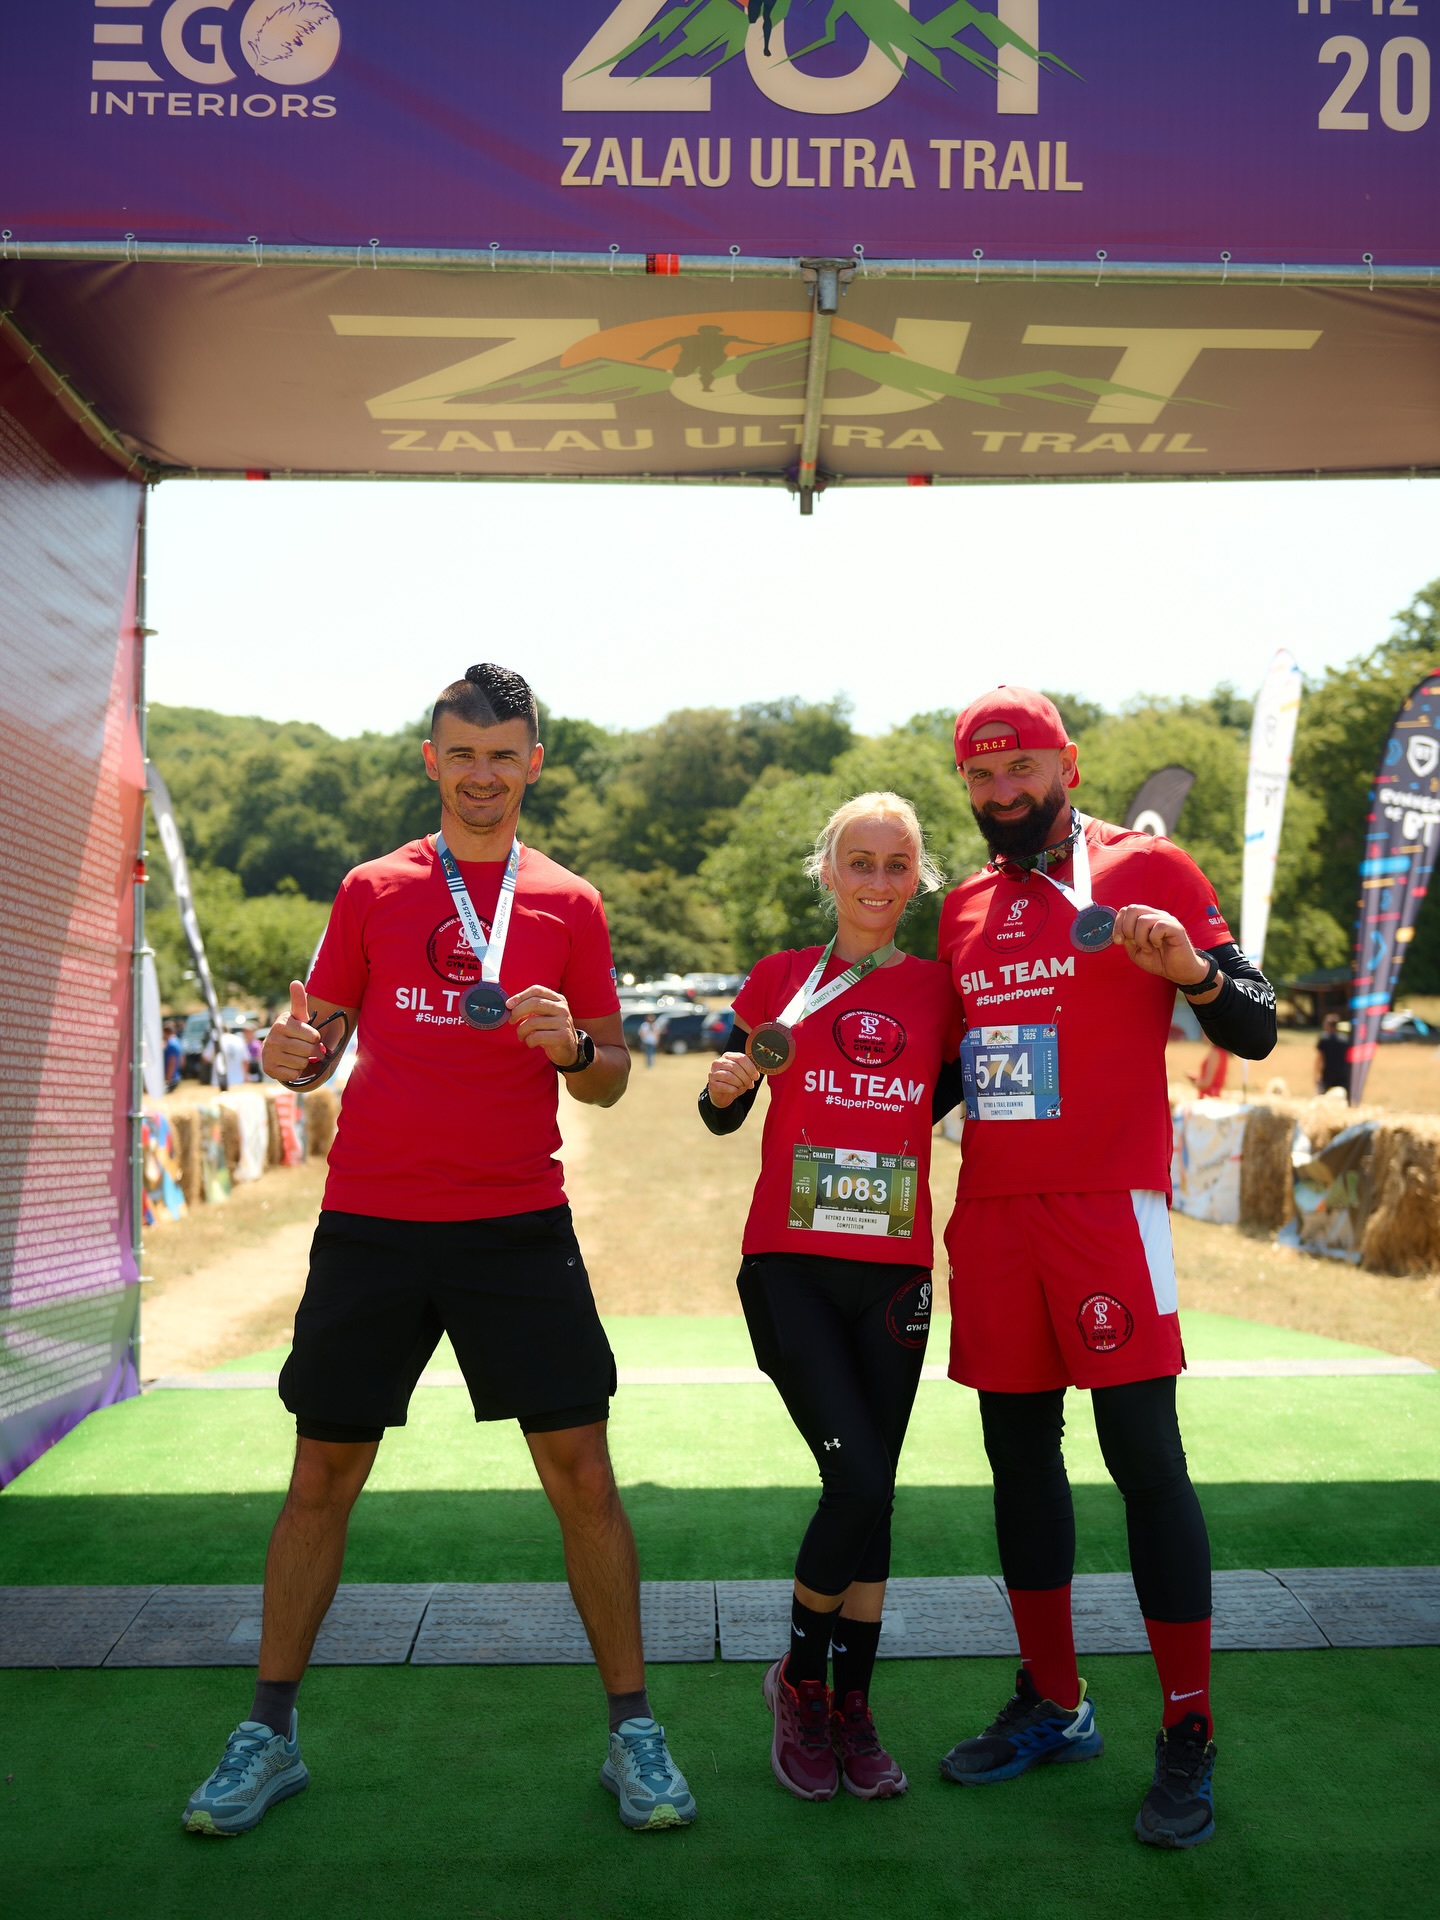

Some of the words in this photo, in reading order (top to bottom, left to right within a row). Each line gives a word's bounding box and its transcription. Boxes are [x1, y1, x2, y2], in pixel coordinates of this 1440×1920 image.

[90, 91, 337, 118] INTERIORS
[561, 137, 732, 187] ZALAU
[750, 138, 916, 190] ULTRA
[929, 139, 1084, 192] TRAIL
[381, 429, 654, 453] ZALAU
[685, 424, 945, 452] ULTRA
[971, 431, 1208, 453] TRAIL
[996, 932, 1013, 940] GYM
[446, 961, 465, 970] GYM
[960, 969, 994, 995] SIL
[999, 956, 1075, 986] TEAM
[395, 987, 434, 1011] SIL
[976, 986, 1055, 1007] #SuperPower
[853, 1044, 872, 1052] GYM
[975, 1052, 1032, 1090] 574
[804, 1069, 843, 1093] SIL
[850, 1073, 925, 1105] TEAM
[825, 1094, 905, 1113] #SuperPower
[812, 1151, 835, 1160] CHARITY
[796, 1185, 810, 1194] 112
[821, 1174, 887, 1204] 1083
[789, 1219, 803, 1227] 1083
[906, 1324, 922, 1332] GYM
